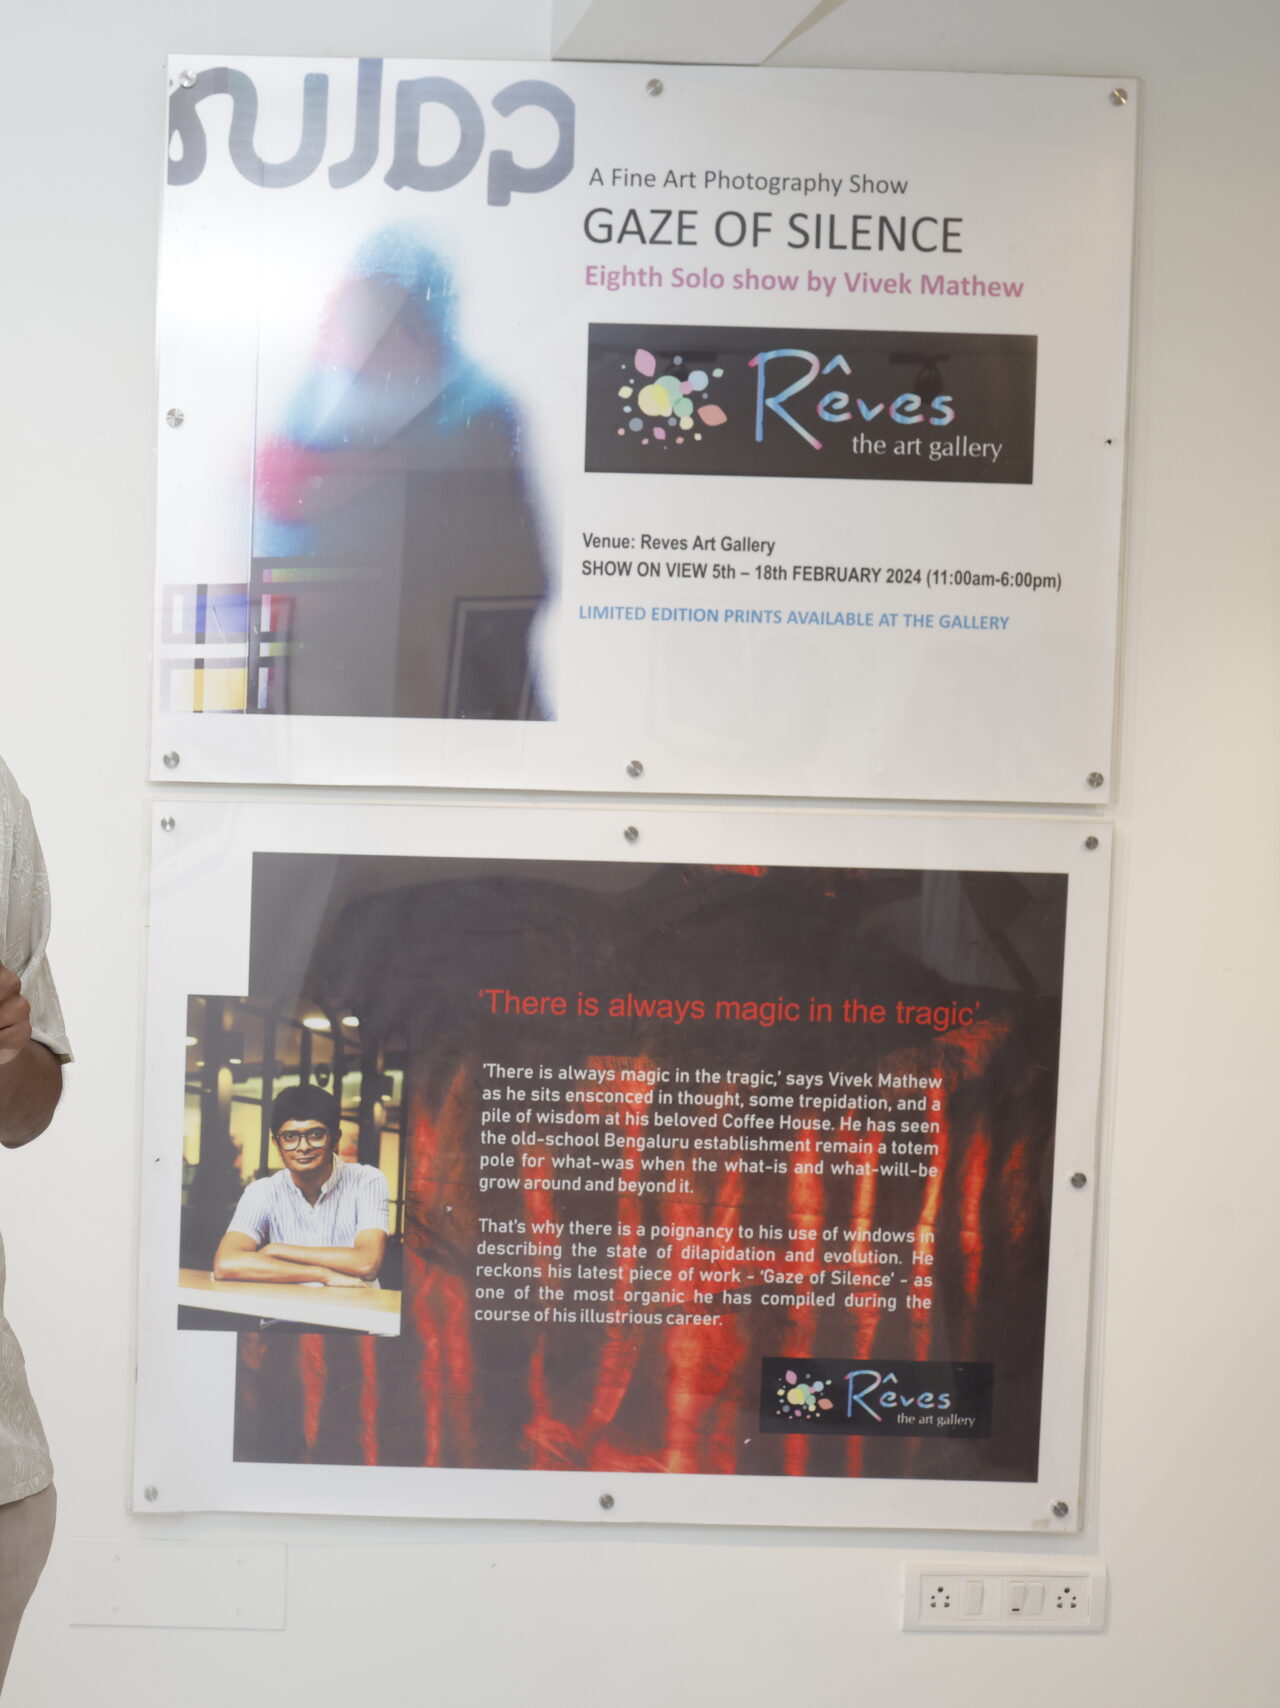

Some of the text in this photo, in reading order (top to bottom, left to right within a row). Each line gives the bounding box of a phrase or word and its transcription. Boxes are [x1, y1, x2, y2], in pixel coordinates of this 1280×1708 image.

[589, 167, 908, 197] A Fine Art Photography Show
[583, 207, 963, 254] GAZE OF SILENCE
[585, 264, 1024, 298] Eighth Solo show by Vivek Mathew
[748, 348, 956, 450] Rêves
[852, 434, 1003, 463] the art gallery
[583, 532, 775, 556] Venue: Reves Art Gallery
[582, 560, 632, 577] SHOW
[637, 561, 661, 578] ON
[666, 562, 707, 579] VIEW
[712, 564, 736, 580] 5th
[755, 565, 787, 581] 18th
[792, 565, 881, 584] FEBRUARY
[886, 568, 921, 585] 2024
[926, 569, 1062, 591] (11:00am-6:00pm)
[580, 605, 1009, 631] LIMITED EDITION PRINTS AVAILABLE AT THE GALLERY
[578, 991, 599, 1016] is
[609, 993, 705, 1024] always
[716, 997, 800, 1027] magic
[810, 997, 832, 1022] in
[843, 999, 886, 1024] the
[539, 1064, 552, 1079] is
[558, 1065, 615, 1083] always
[621, 1068, 669, 1085] magic
[676, 1068, 689, 1082] in
[696, 1068, 720, 1083] the
[786, 1074, 823, 1089] says
[829, 1071, 872, 1087] Vivek
[879, 1073, 942, 1089] Mathew
[483, 1086, 940, 1112] as he sits ensconced in thought, some trepidation, and a
[482, 1108, 939, 1133] pile of wisdom at his beloved Coffee House. He has seen
[481, 1130, 938, 1155] the old-school Bengaluru establishment remain a totem
[480, 1152, 937, 1177] pole for what-was when the what-is and what-will-be
[479, 1176, 693, 1196] grow around and beyond it.
[532, 1220, 564, 1236] why
[569, 1220, 612, 1235] there
[618, 1221, 631, 1236] is
[637, 1224, 645, 1236] a
[651, 1222, 733, 1241] poignancy
[738, 1225, 753, 1239] to
[759, 1224, 782, 1240] his
[788, 1229, 816, 1240] use
[822, 1226, 838, 1241] of
[843, 1227, 915, 1242] windows
[920, 1227, 934, 1242] in
[477, 1241, 933, 1265] describing the state of dilapidation and evolution. He
[476, 1263, 541, 1278] reckons
[548, 1264, 571, 1279] his
[578, 1265, 623, 1280] latest
[630, 1266, 672, 1283] piece
[678, 1267, 694, 1281] of
[700, 1268, 740, 1282] work
[810, 1270, 826, 1285] of
[914, 1275, 932, 1286] as
[475, 1285, 931, 1311] one of the most organic he has compiled during the
[474, 1307, 722, 1326] course of his illustrious career.
[844, 1369, 951, 1422] Rêves
[897, 1414, 975, 1427] the art gallery
